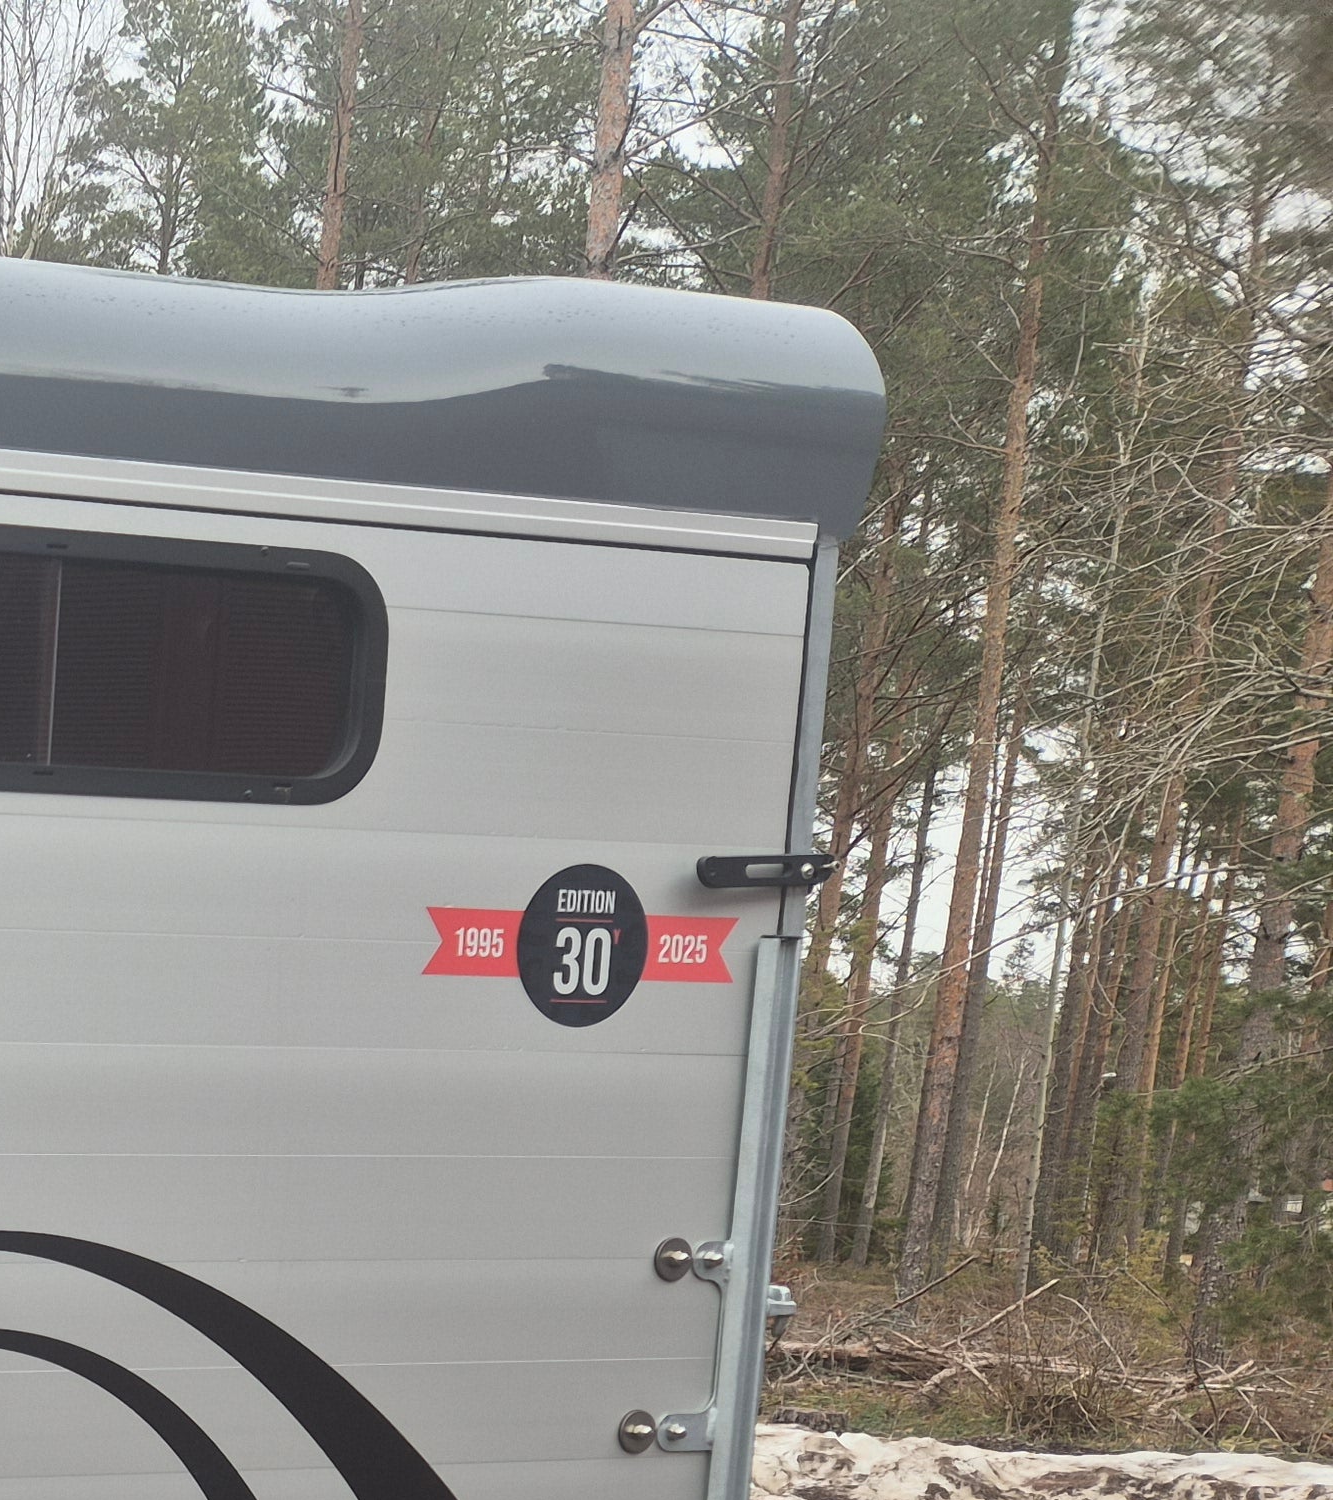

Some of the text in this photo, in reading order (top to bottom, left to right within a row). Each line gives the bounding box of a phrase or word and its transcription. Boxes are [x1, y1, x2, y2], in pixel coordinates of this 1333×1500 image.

[556, 888, 616, 915] EDITION
[454, 926, 505, 959] 1995
[657, 933, 709, 965] 2025
[552, 926, 612, 997] 30
